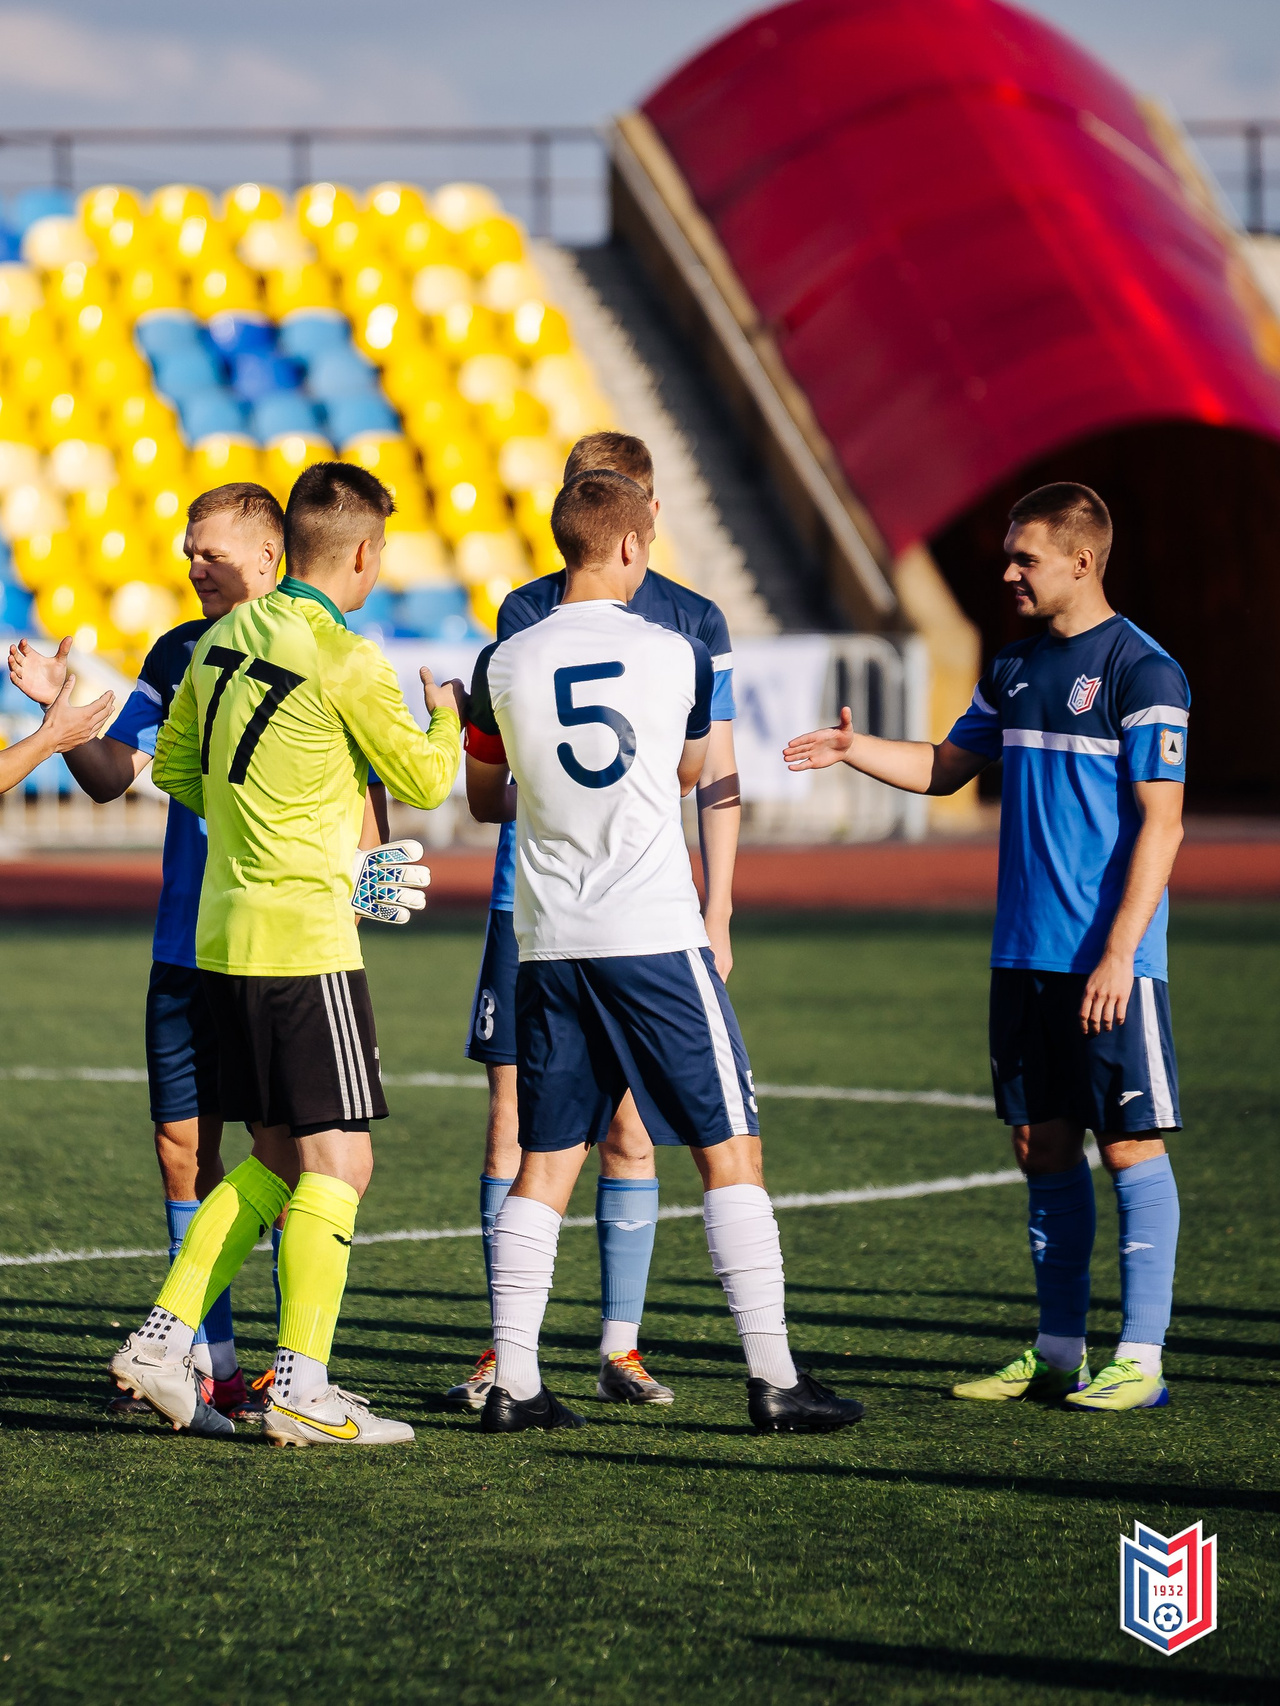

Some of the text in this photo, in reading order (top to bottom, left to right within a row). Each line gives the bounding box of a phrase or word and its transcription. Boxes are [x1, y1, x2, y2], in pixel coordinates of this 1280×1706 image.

[201, 645, 307, 785] 77
[554, 661, 636, 788] 5
[475, 989, 495, 1040] 8
